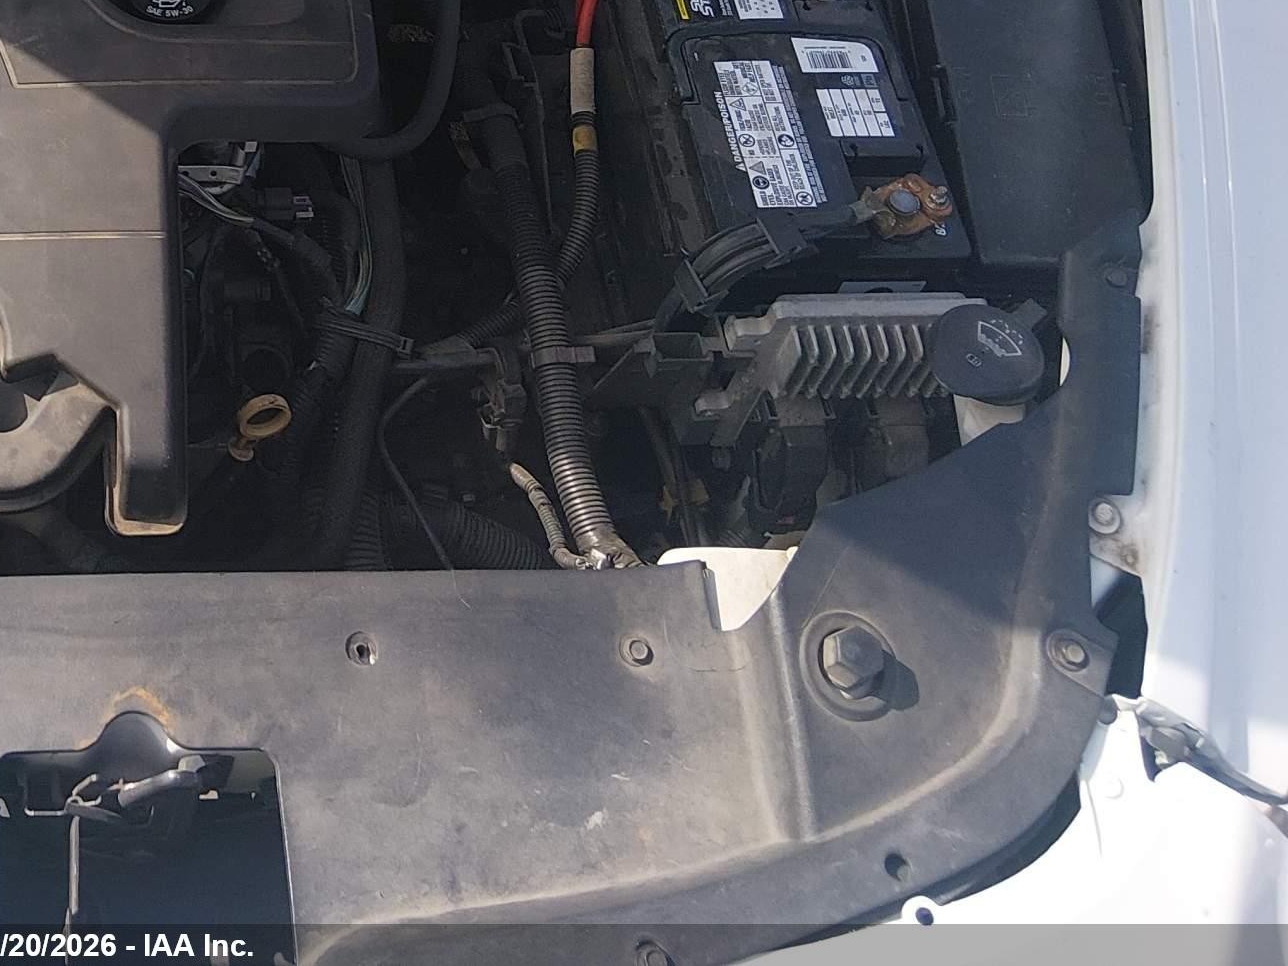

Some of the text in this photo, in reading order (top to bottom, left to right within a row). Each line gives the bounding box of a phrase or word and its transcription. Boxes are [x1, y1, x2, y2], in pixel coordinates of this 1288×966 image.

[146, 5, 194, 17] SAE 5W-30
[713, 91, 742, 162] DANGER/POISON
